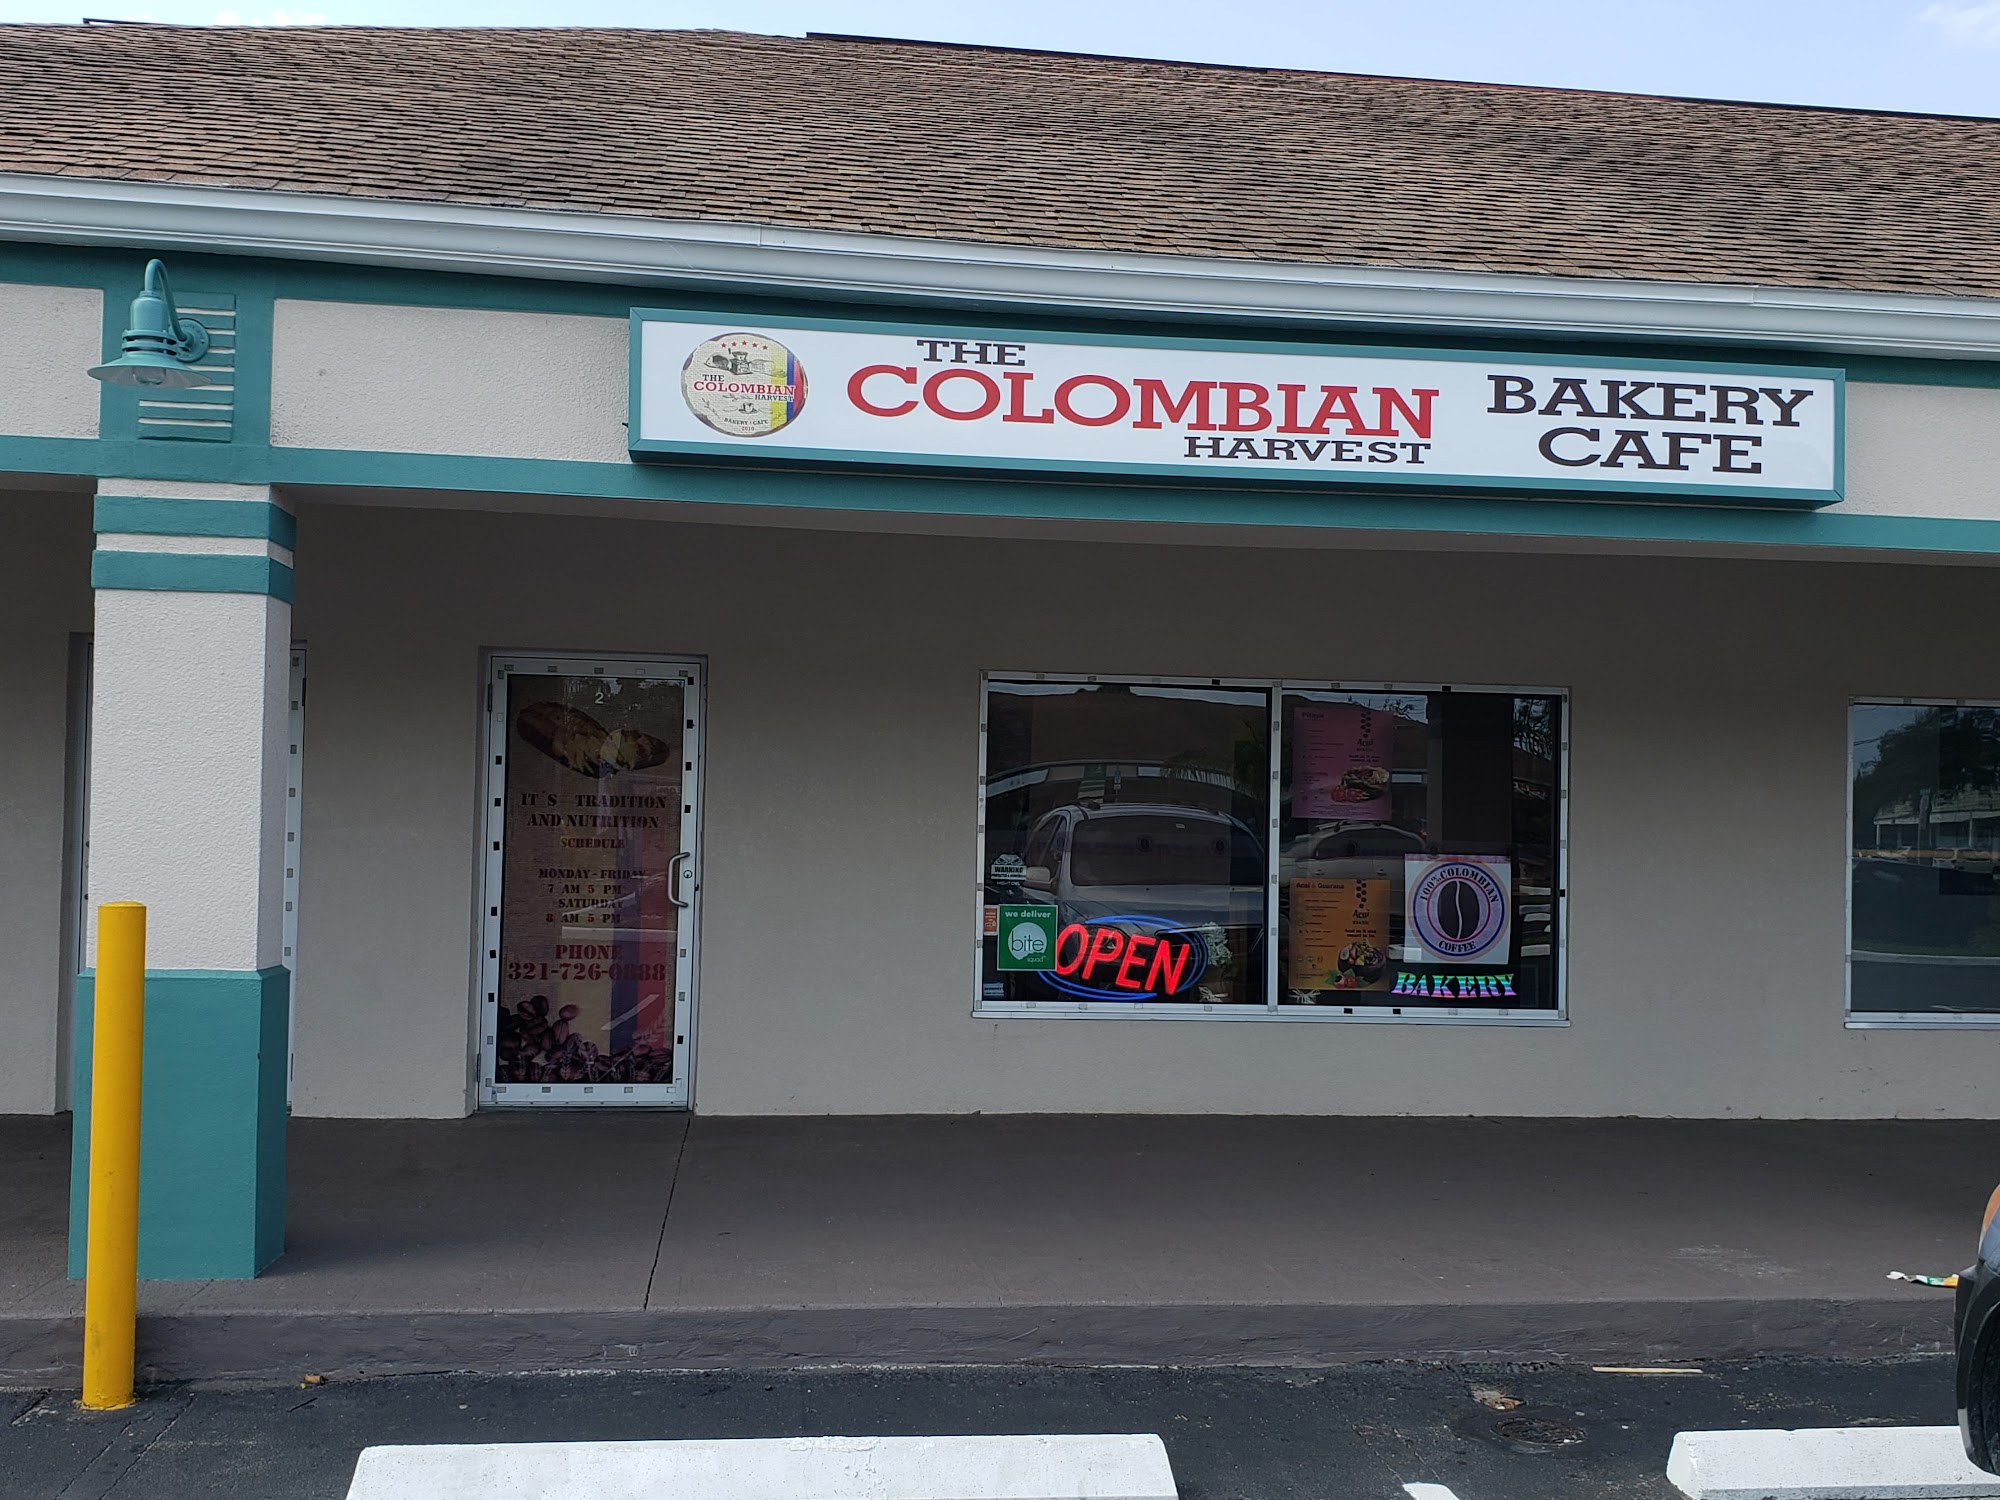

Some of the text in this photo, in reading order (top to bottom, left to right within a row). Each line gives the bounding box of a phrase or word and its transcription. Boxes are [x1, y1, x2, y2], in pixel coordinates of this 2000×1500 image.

[916, 340, 1026, 367] THE
[702, 374, 725, 382] THE
[693, 381, 795, 396] COLOMBIAN
[754, 394, 794, 402] HARVEST
[847, 364, 1439, 439] COLOMBIAN
[1486, 375, 1814, 427] BAKERY
[1183, 436, 1431, 465] HARVEST
[1537, 427, 1763, 474] CAFE
[595, 692, 604, 705] 2
[575, 793, 667, 809] TRADITION
[527, 813, 660, 829] AND NUTRITION
[560, 837, 626, 849] SCHEDULE
[539, 868, 591, 879] MONDAY
[600, 869, 646, 880] FRIDAY
[547, 884, 622, 894] 7 AM 5 PM
[1440, 867, 1499, 903] COLOMBIAN
[558, 898, 624, 909] SATURDAY
[545, 914, 621, 924] 8 AM 5 PM
[1021, 910, 1051, 918] deliver
[1011, 930, 1044, 951] bite
[1438, 940, 1477, 952] COFFEE
[555, 944, 622, 960] PHONE
[1056, 923, 1190, 996] OPEN
[1391, 971, 1517, 998] BAKERY
